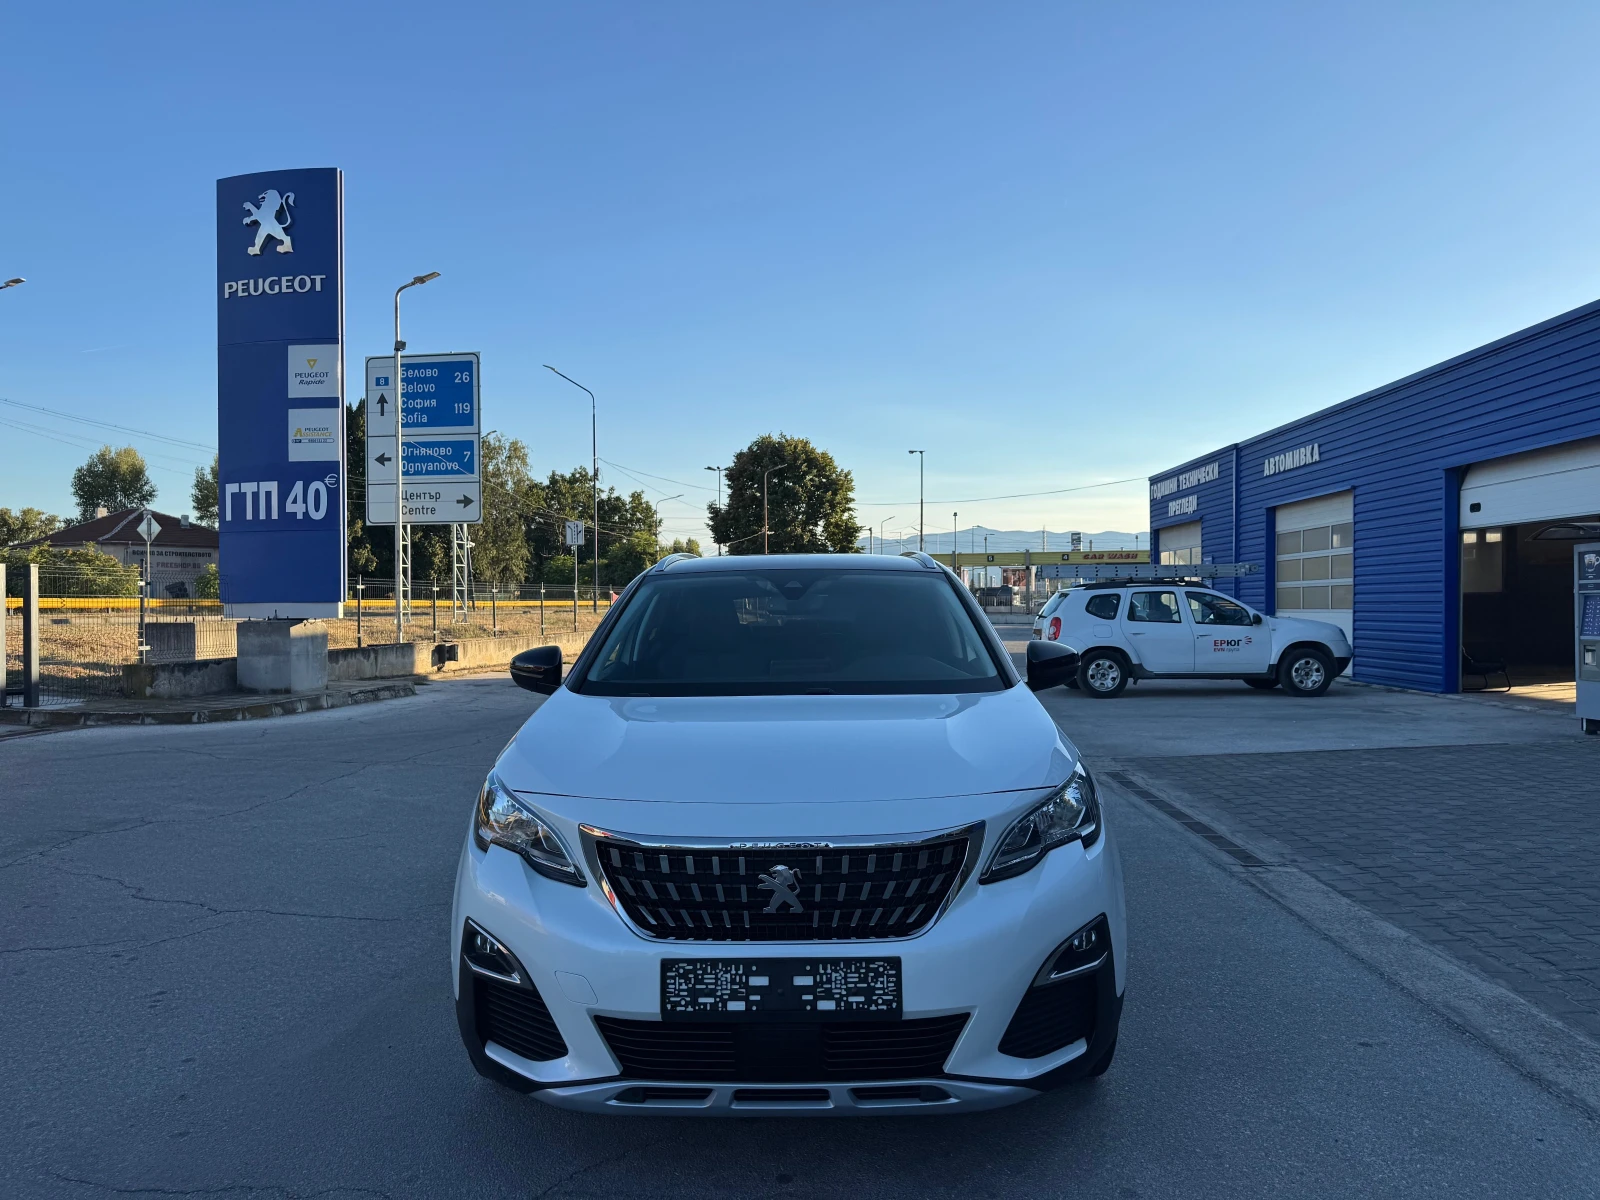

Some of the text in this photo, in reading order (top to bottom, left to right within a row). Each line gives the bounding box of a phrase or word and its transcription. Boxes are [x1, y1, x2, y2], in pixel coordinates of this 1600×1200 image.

[224, 275, 326, 299] PEUGEOT
[294, 371, 329, 379] PEUGEOT
[379, 377, 385, 385] 8
[401, 367, 470, 383] Белово 26
[401, 382, 436, 393] Belovo
[401, 397, 471, 414] София 119
[401, 412, 428, 424] Sofia
[401, 445, 471, 462] Огняново 7
[1263, 443, 1320, 477] АВТОМИВКА
[401, 460, 459, 474] Ognyanovo
[1151, 461, 1219, 500] ГОДИШНИ ТЕХНИЧЕСКИ
[225, 481, 279, 521] ГТП
[401, 489, 441, 502] Център
[401, 505, 437, 516] Centre
[1168, 495, 1198, 517] ПРЕГЛЕДИ
[1106, 552, 1139, 560] WASH
[1213, 639, 1242, 647] ЕРЮГ
[739, 842, 822, 850] PEUGEOT
